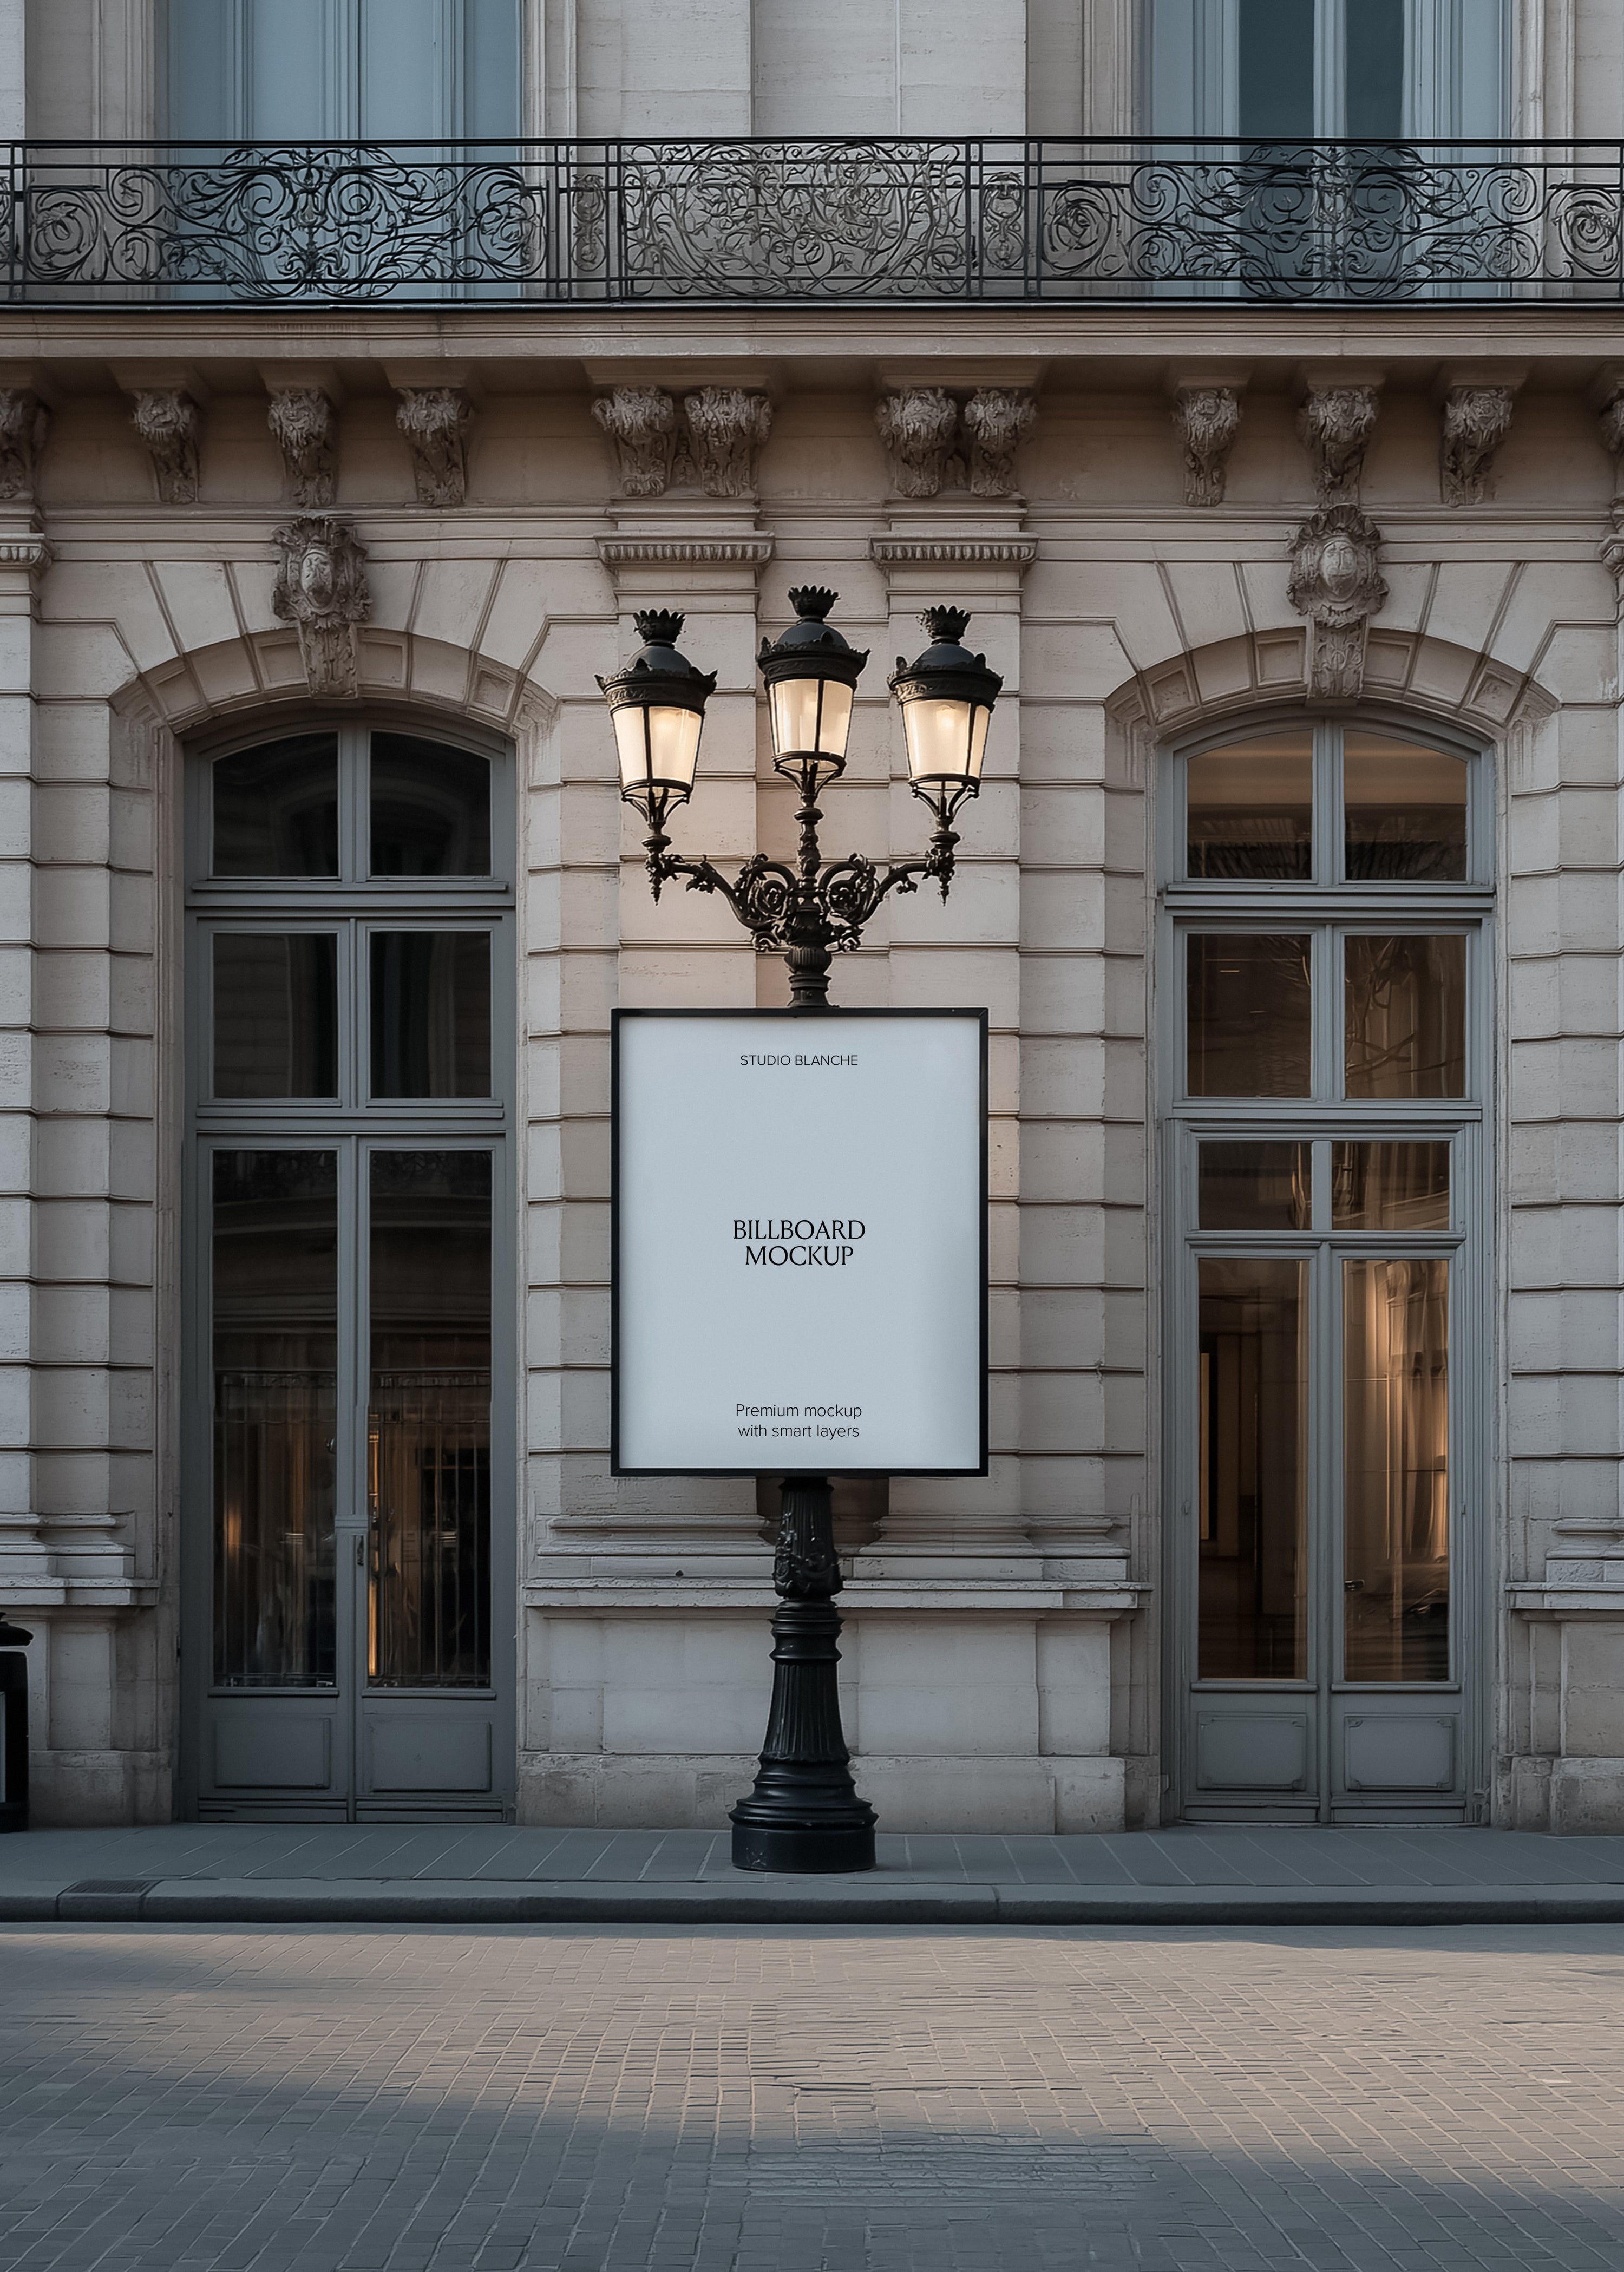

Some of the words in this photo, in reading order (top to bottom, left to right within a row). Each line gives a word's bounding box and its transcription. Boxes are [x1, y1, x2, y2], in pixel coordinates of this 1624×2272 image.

[740, 1055, 791, 1066] STUDIO
[795, 1055, 858, 1066] BLANCHE
[733, 1219, 866, 1240] BILLBOARD
[745, 1245, 854, 1266] MOCKUP
[736, 1404, 798, 1417] Premium
[804, 1404, 862, 1420] mockup
[738, 1424, 767, 1437] with
[772, 1424, 813, 1437] smart
[817, 1424, 860, 1441] layers
